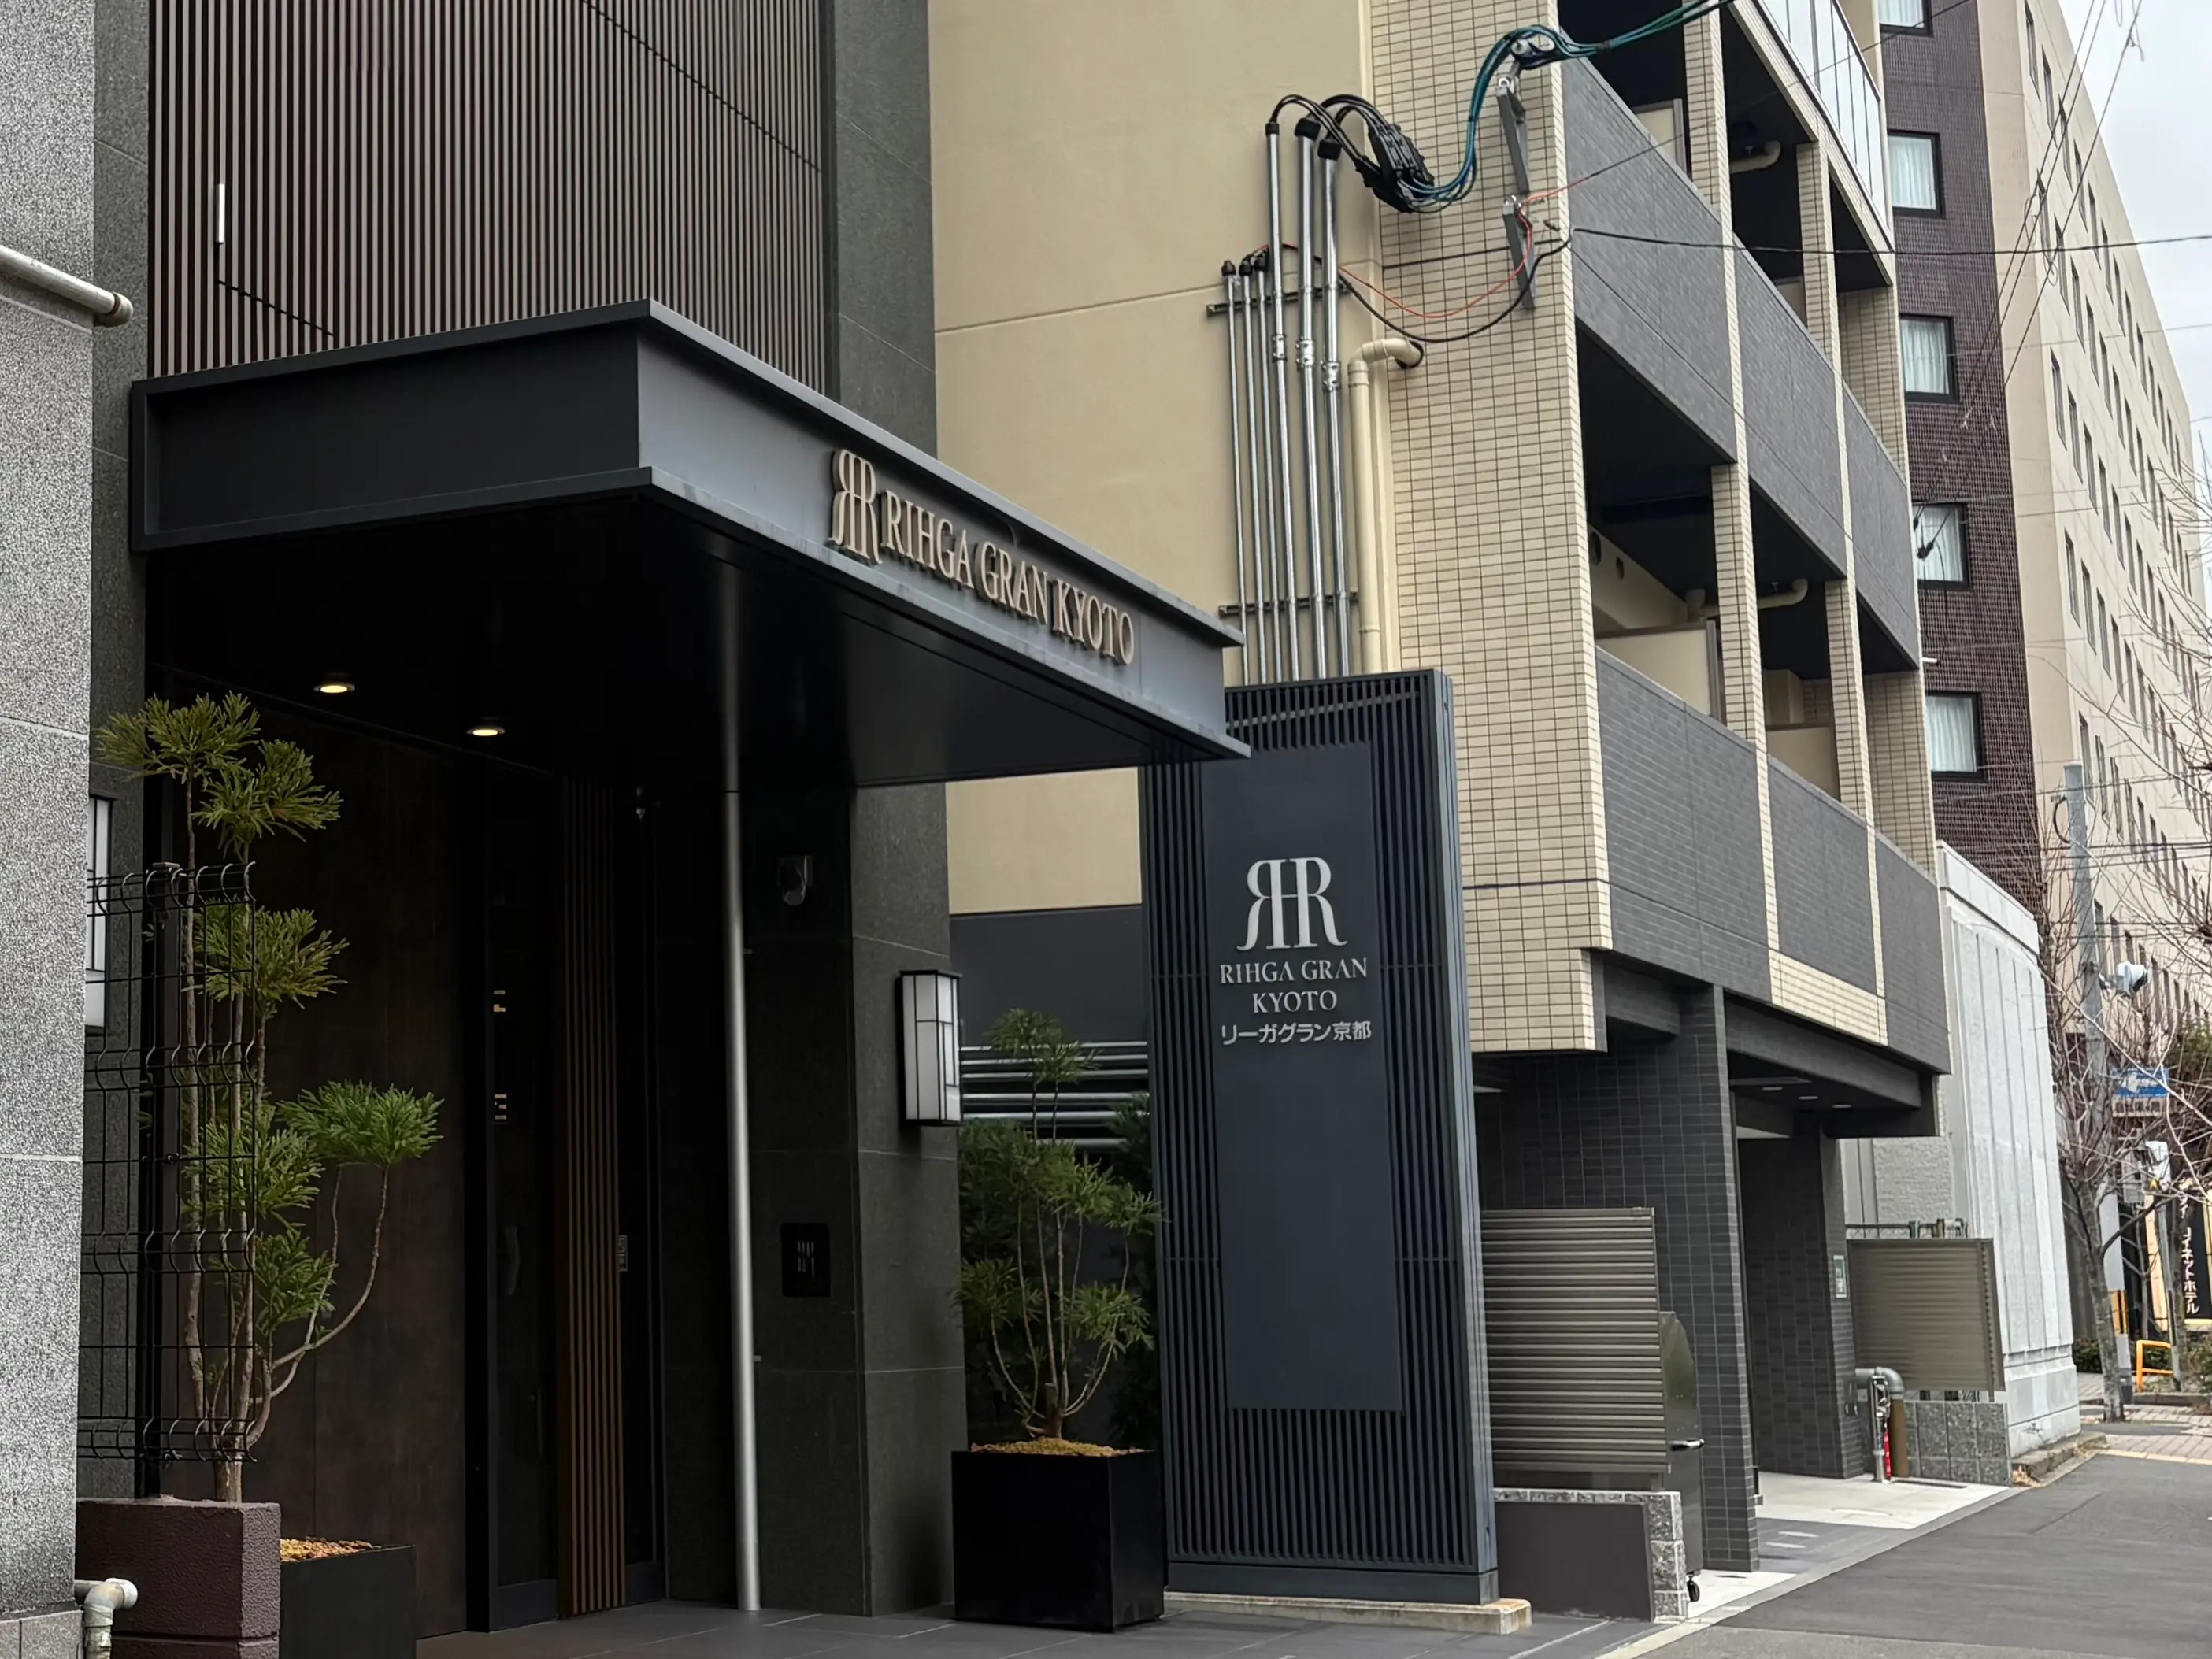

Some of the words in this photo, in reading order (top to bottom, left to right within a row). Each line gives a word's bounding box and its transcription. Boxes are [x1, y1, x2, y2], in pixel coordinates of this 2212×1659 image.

[880, 489, 975, 590] RIHGA
[975, 540, 1048, 625] GRAN
[1052, 578, 1135, 665] KYOTO
[1220, 961, 1295, 984] RIHGA
[1301, 957, 1368, 981] GRAN
[1252, 989, 1338, 1013] KYOTO
[1221, 1020, 1372, 1046] リーガグラン京都
